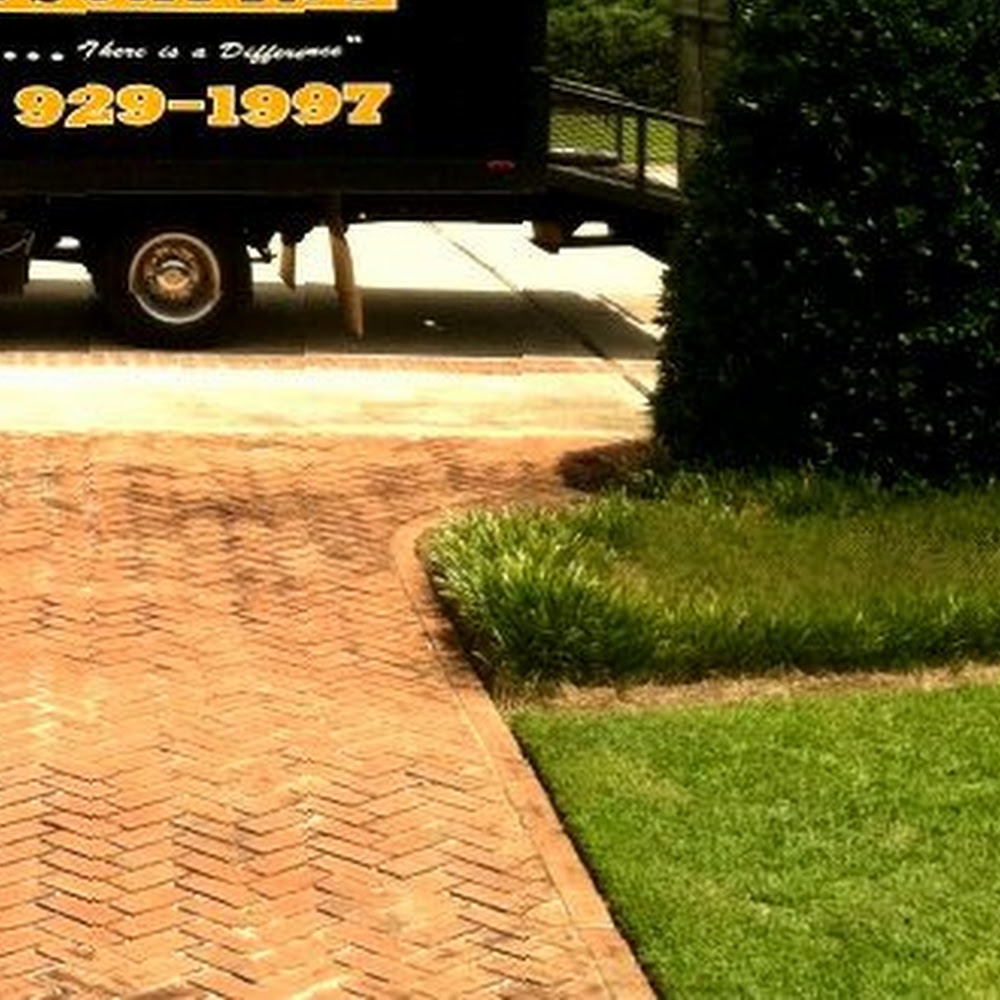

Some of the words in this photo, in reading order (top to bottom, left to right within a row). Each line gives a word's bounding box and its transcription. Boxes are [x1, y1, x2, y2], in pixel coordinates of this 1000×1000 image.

[77, 39, 146, 61] There
[157, 43, 179, 59] is
[191, 45, 206, 59] a
[13, 81, 392, 131] 929-1997
